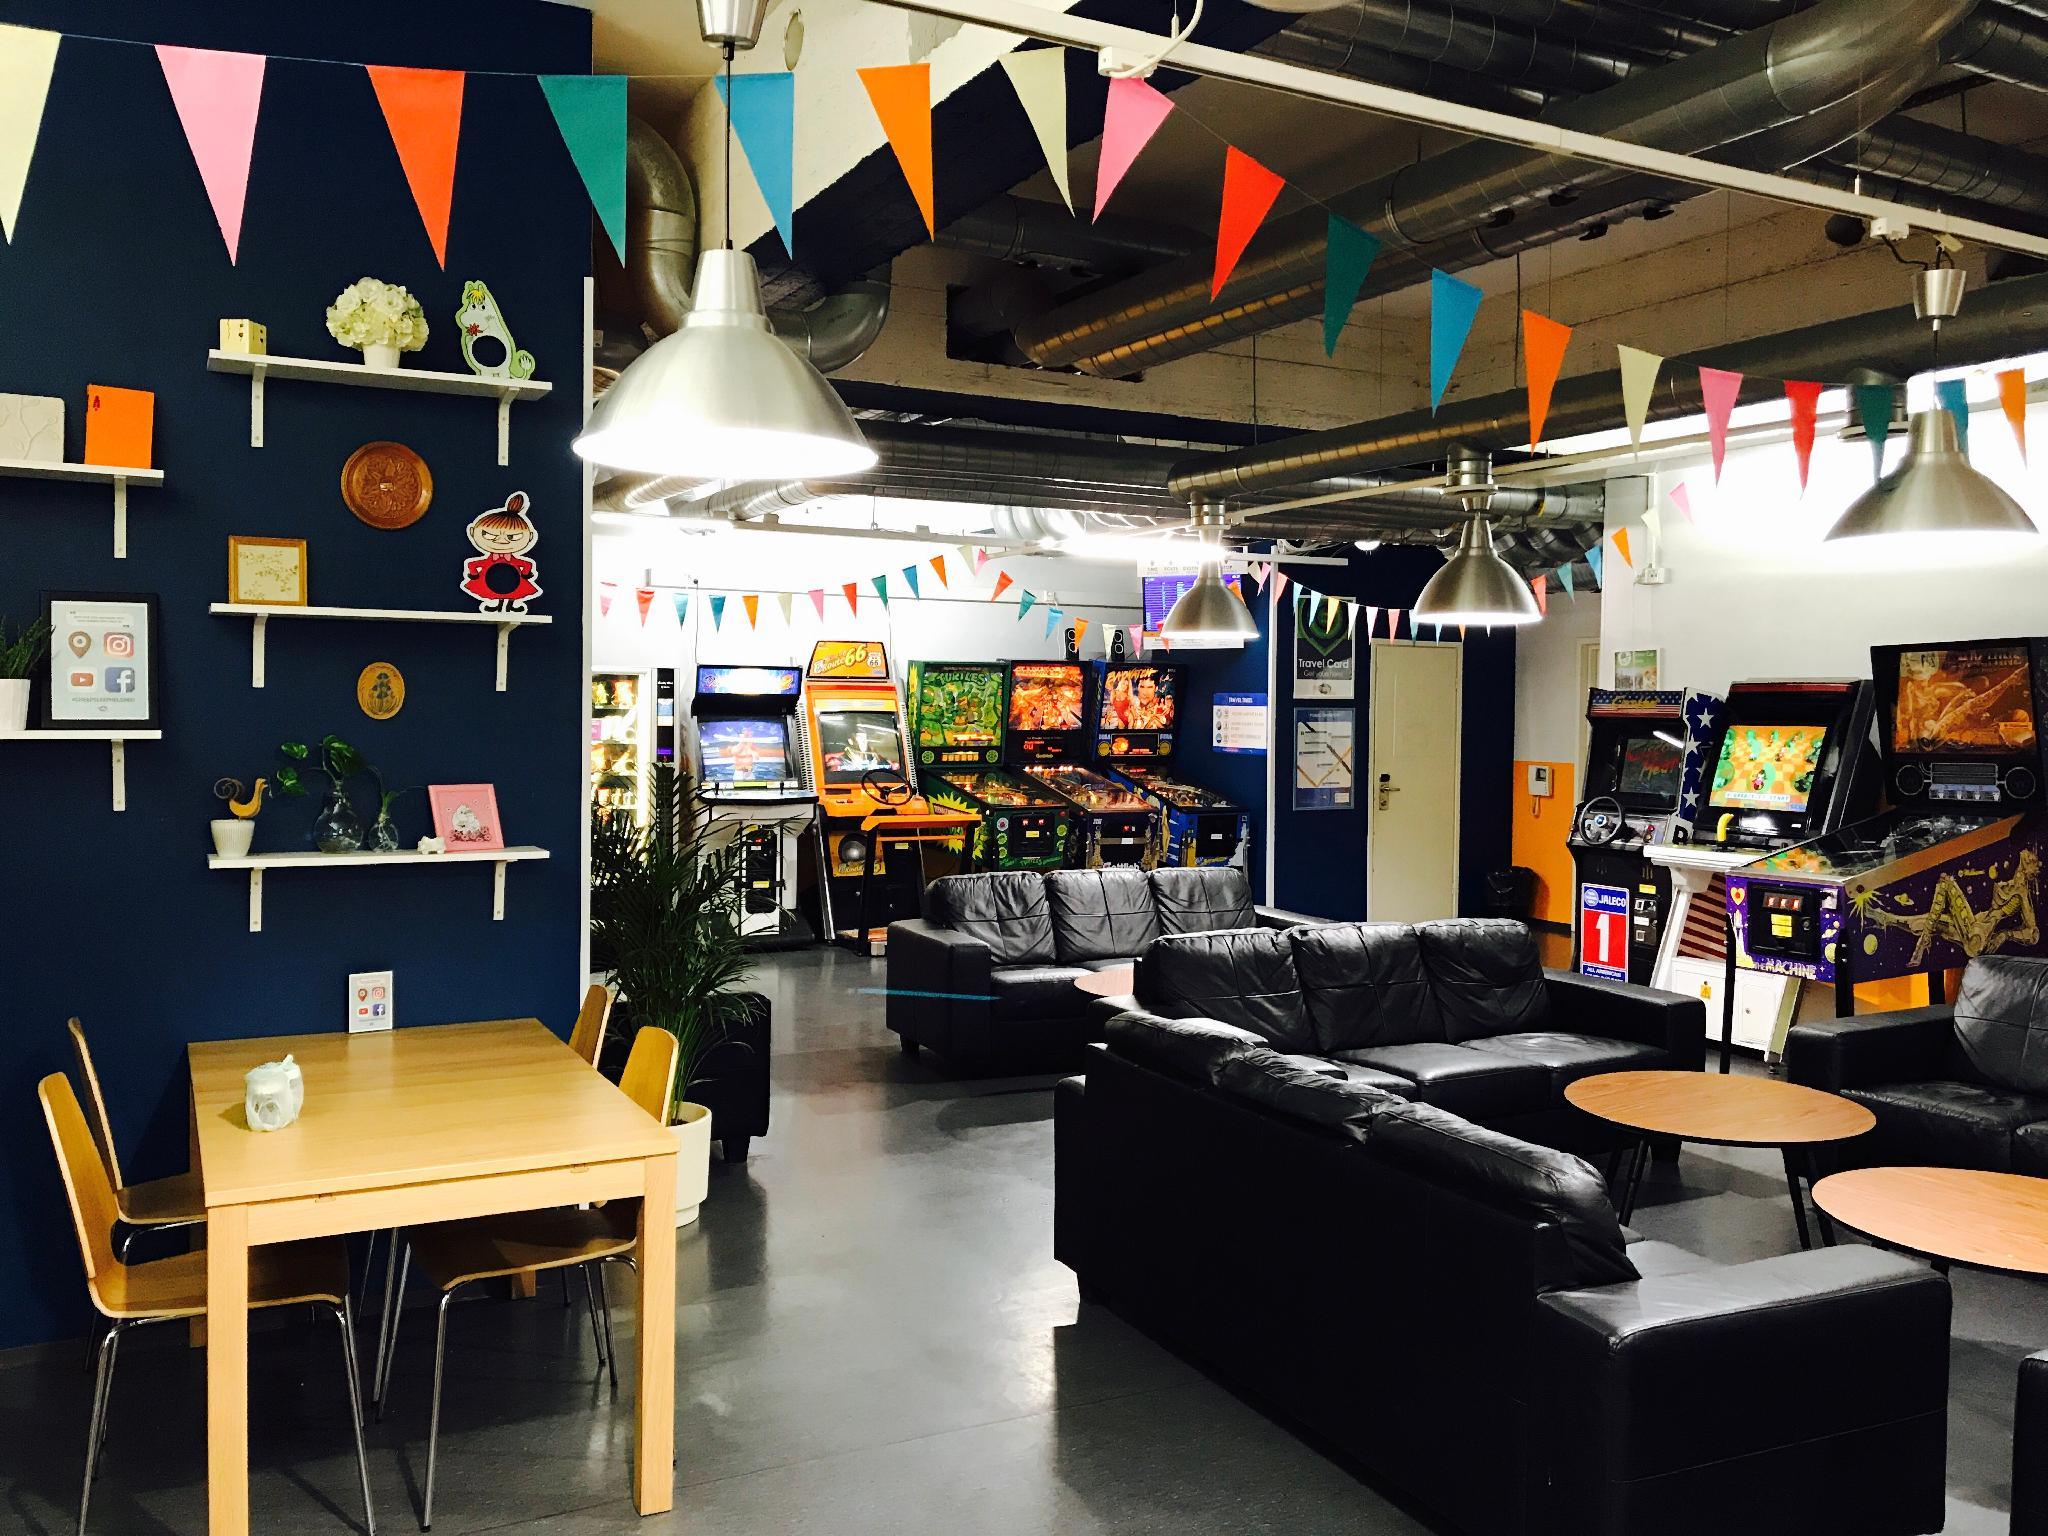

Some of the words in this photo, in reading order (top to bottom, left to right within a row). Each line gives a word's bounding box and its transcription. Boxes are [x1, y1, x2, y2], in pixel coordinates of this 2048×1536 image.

[844, 643, 868, 667] 66
[1298, 658, 1325, 668] Travel
[1326, 658, 1349, 669] Card
[939, 672, 986, 686] TURTLES
[1598, 894, 1626, 908] JALECO
[1595, 913, 1610, 963] 1
[1766, 957, 1817, 980] MACHINE
